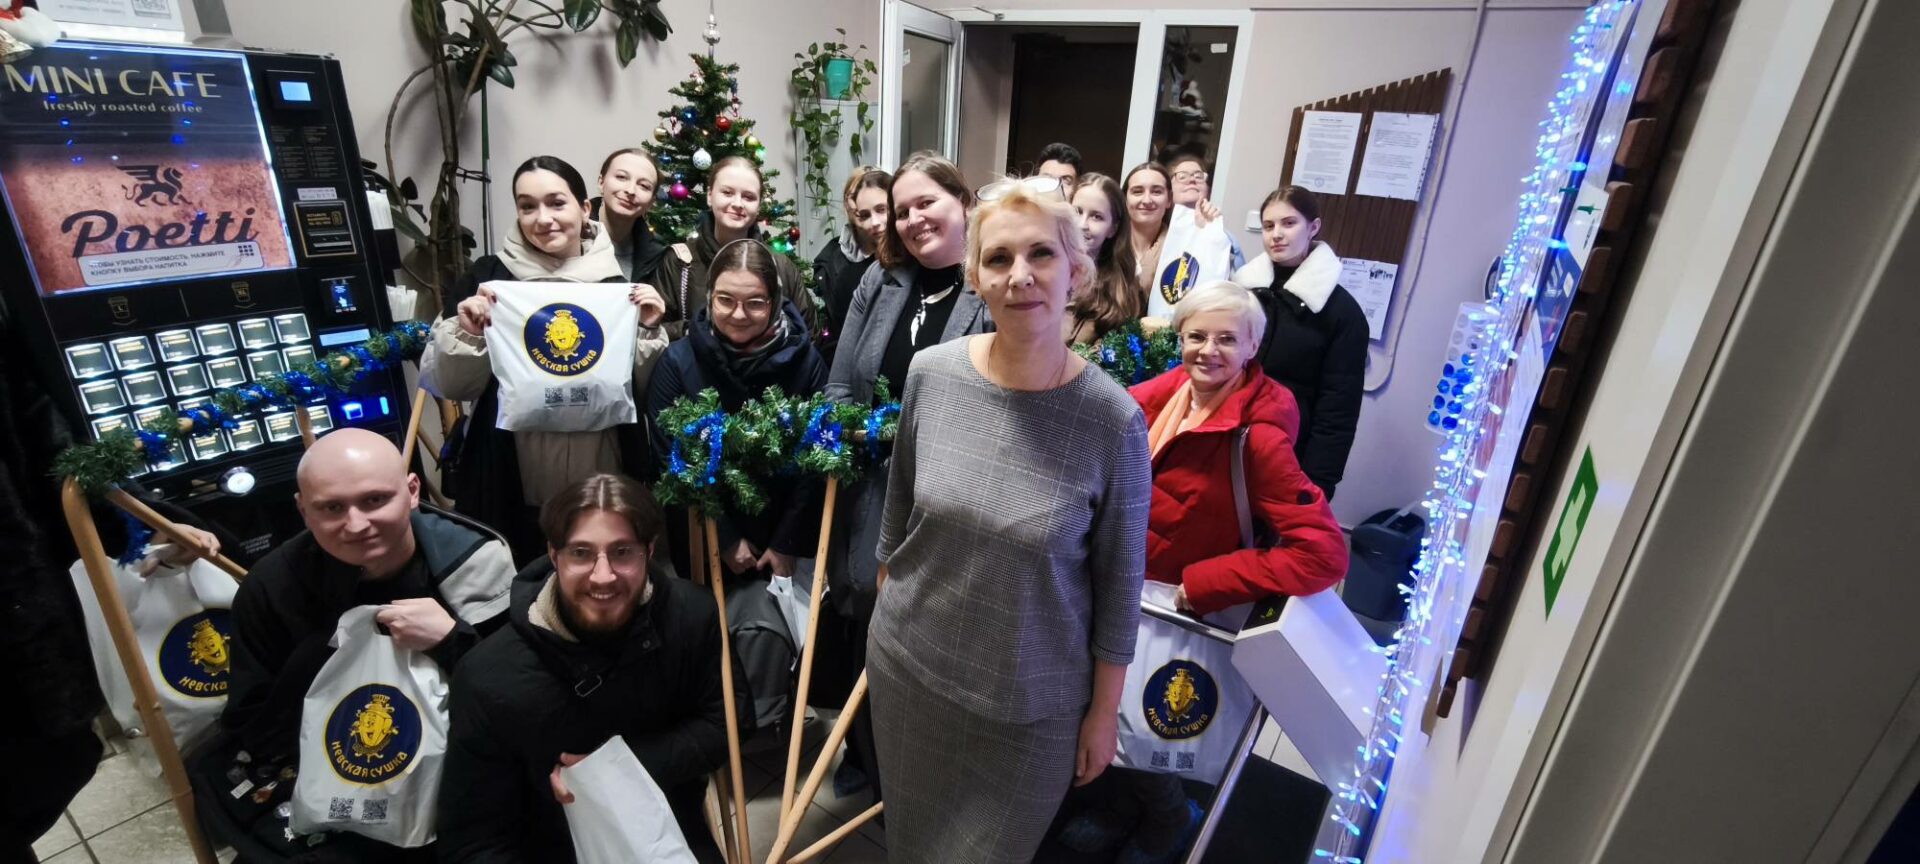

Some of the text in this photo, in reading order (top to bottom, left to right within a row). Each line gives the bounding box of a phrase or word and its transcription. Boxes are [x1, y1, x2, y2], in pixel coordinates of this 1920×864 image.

[3, 64, 222, 98] MINI CAFE
[43, 100, 203, 114] freshly roasted coffee
[60, 207, 261, 258] Poetti
[178, 675, 228, 692] Невска
